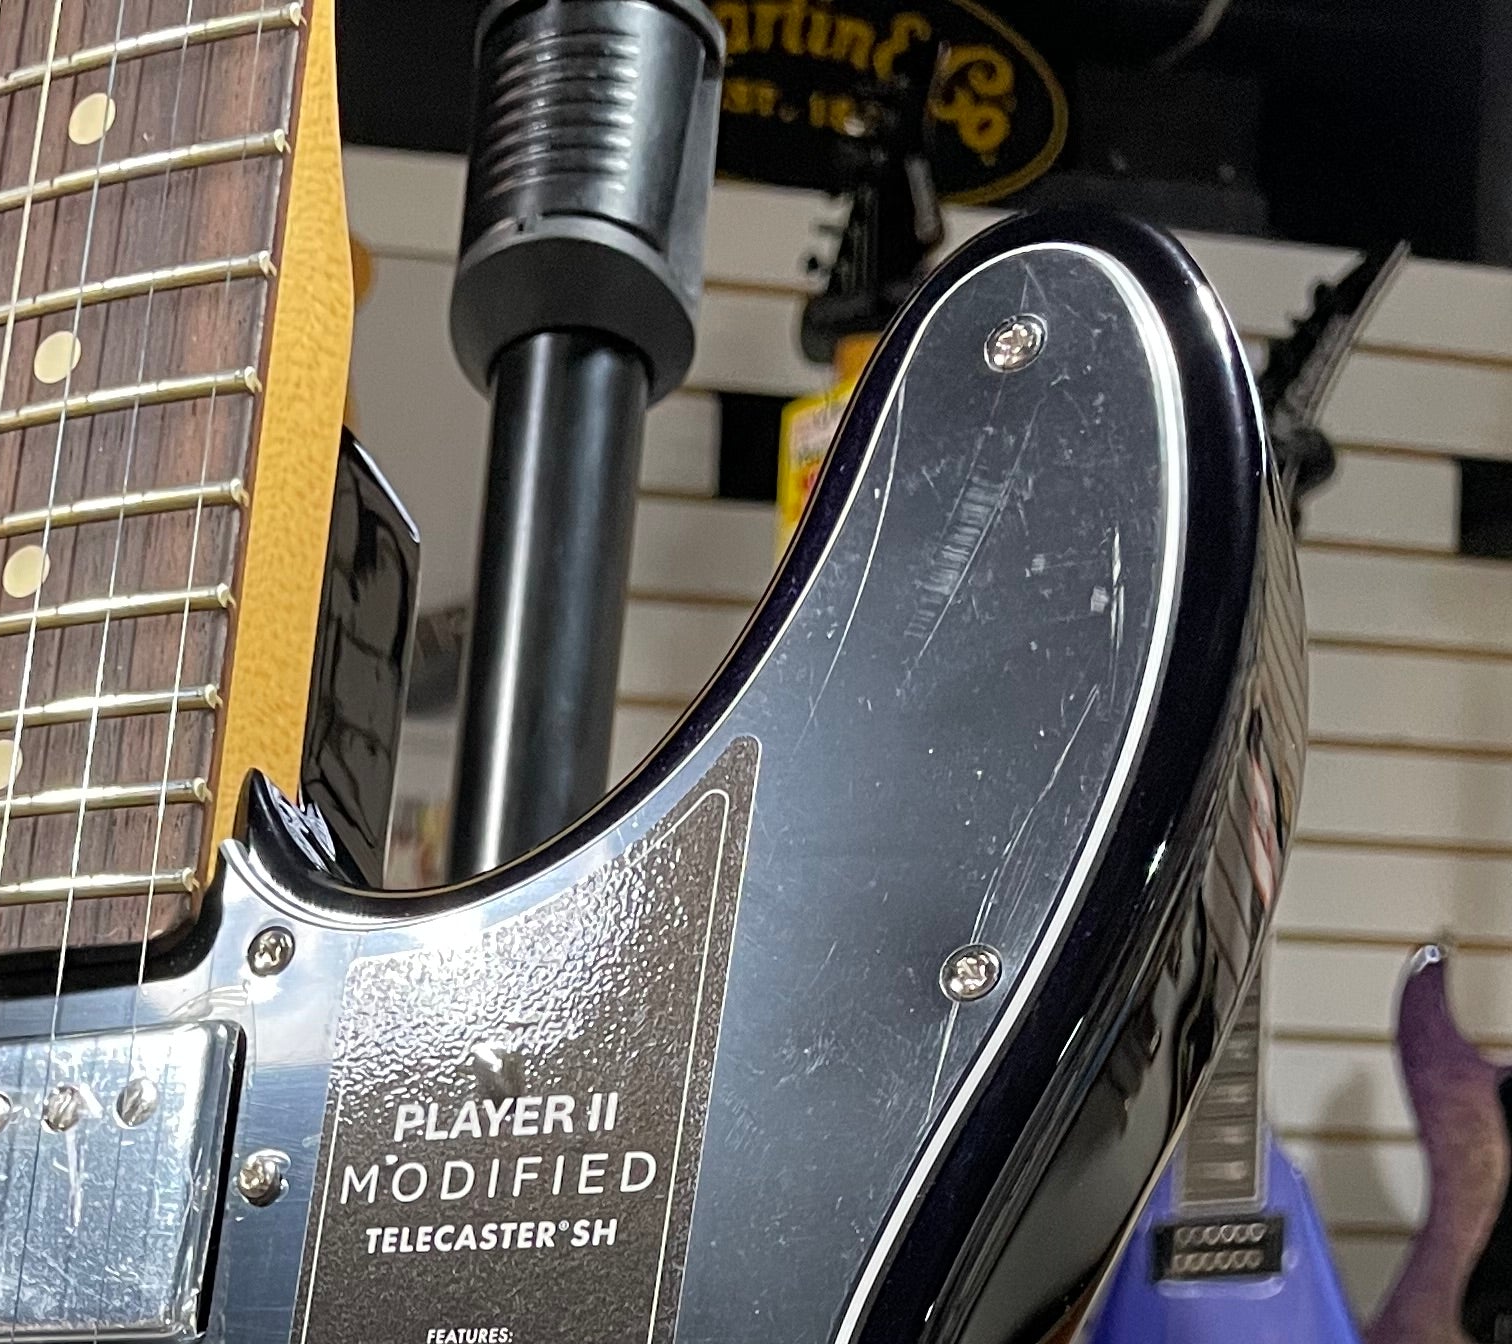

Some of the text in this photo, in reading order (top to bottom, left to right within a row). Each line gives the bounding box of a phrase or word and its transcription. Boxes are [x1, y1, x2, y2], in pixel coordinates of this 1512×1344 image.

[714, 0, 876, 70] artin
[393, 1091, 619, 1143] PLAYER II
[339, 1151, 658, 1205] MODIFIED
[426, 1327, 514, 1344] FEATURES:
